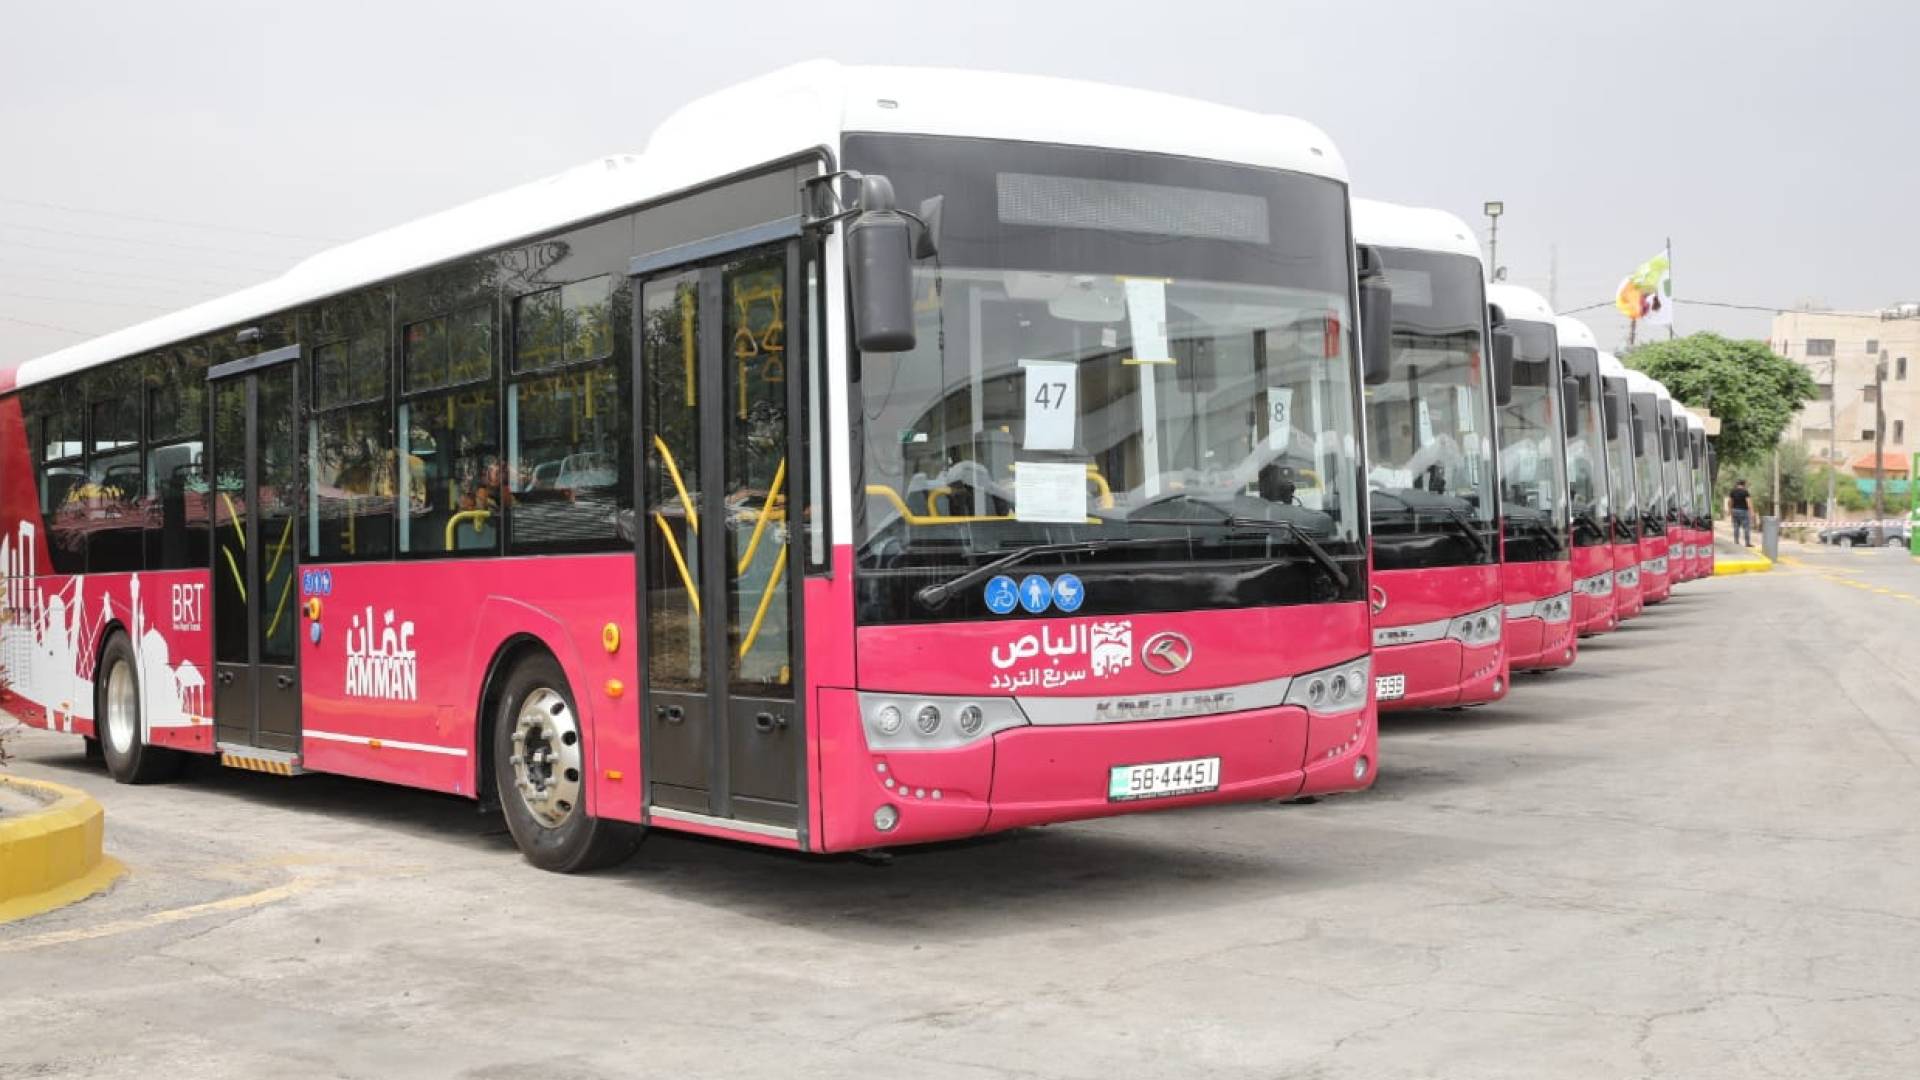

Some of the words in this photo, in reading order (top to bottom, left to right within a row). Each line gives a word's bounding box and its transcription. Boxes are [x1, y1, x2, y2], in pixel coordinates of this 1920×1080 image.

[1034, 382, 1067, 410] 47
[172, 583, 204, 622] BRT
[990, 623, 1087, 669] الباص
[345, 656, 416, 701] AMMAN
[989, 668, 1039, 692] التردد
[1042, 668, 1086, 689] سريع
